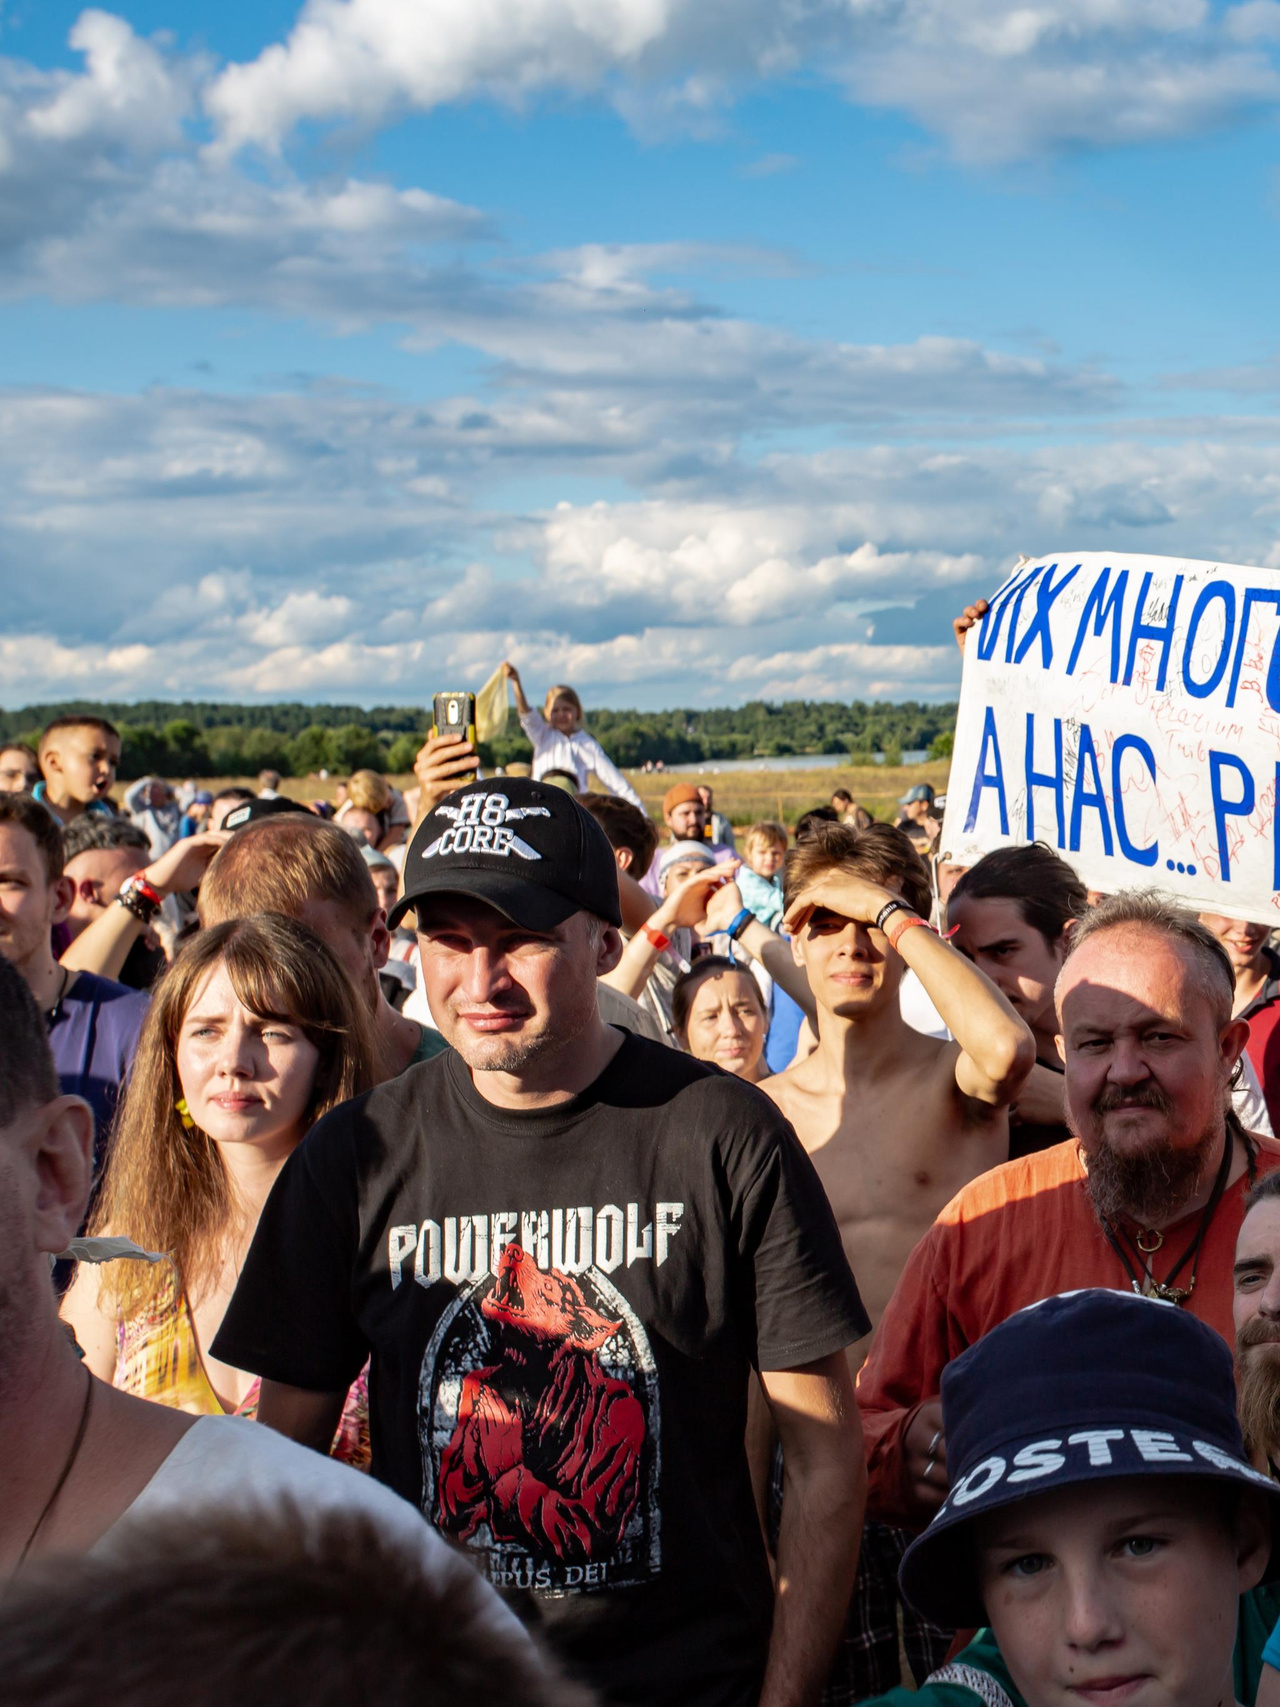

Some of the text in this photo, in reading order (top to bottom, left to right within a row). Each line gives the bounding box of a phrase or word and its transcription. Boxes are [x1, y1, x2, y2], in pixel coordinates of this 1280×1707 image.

[977, 563, 1082, 670] ИХ
[454, 792, 509, 828] H8
[963, 707, 1010, 836] А
[438, 825, 514, 857] CORE
[388, 1202, 685, 1292] POWERWOLF
